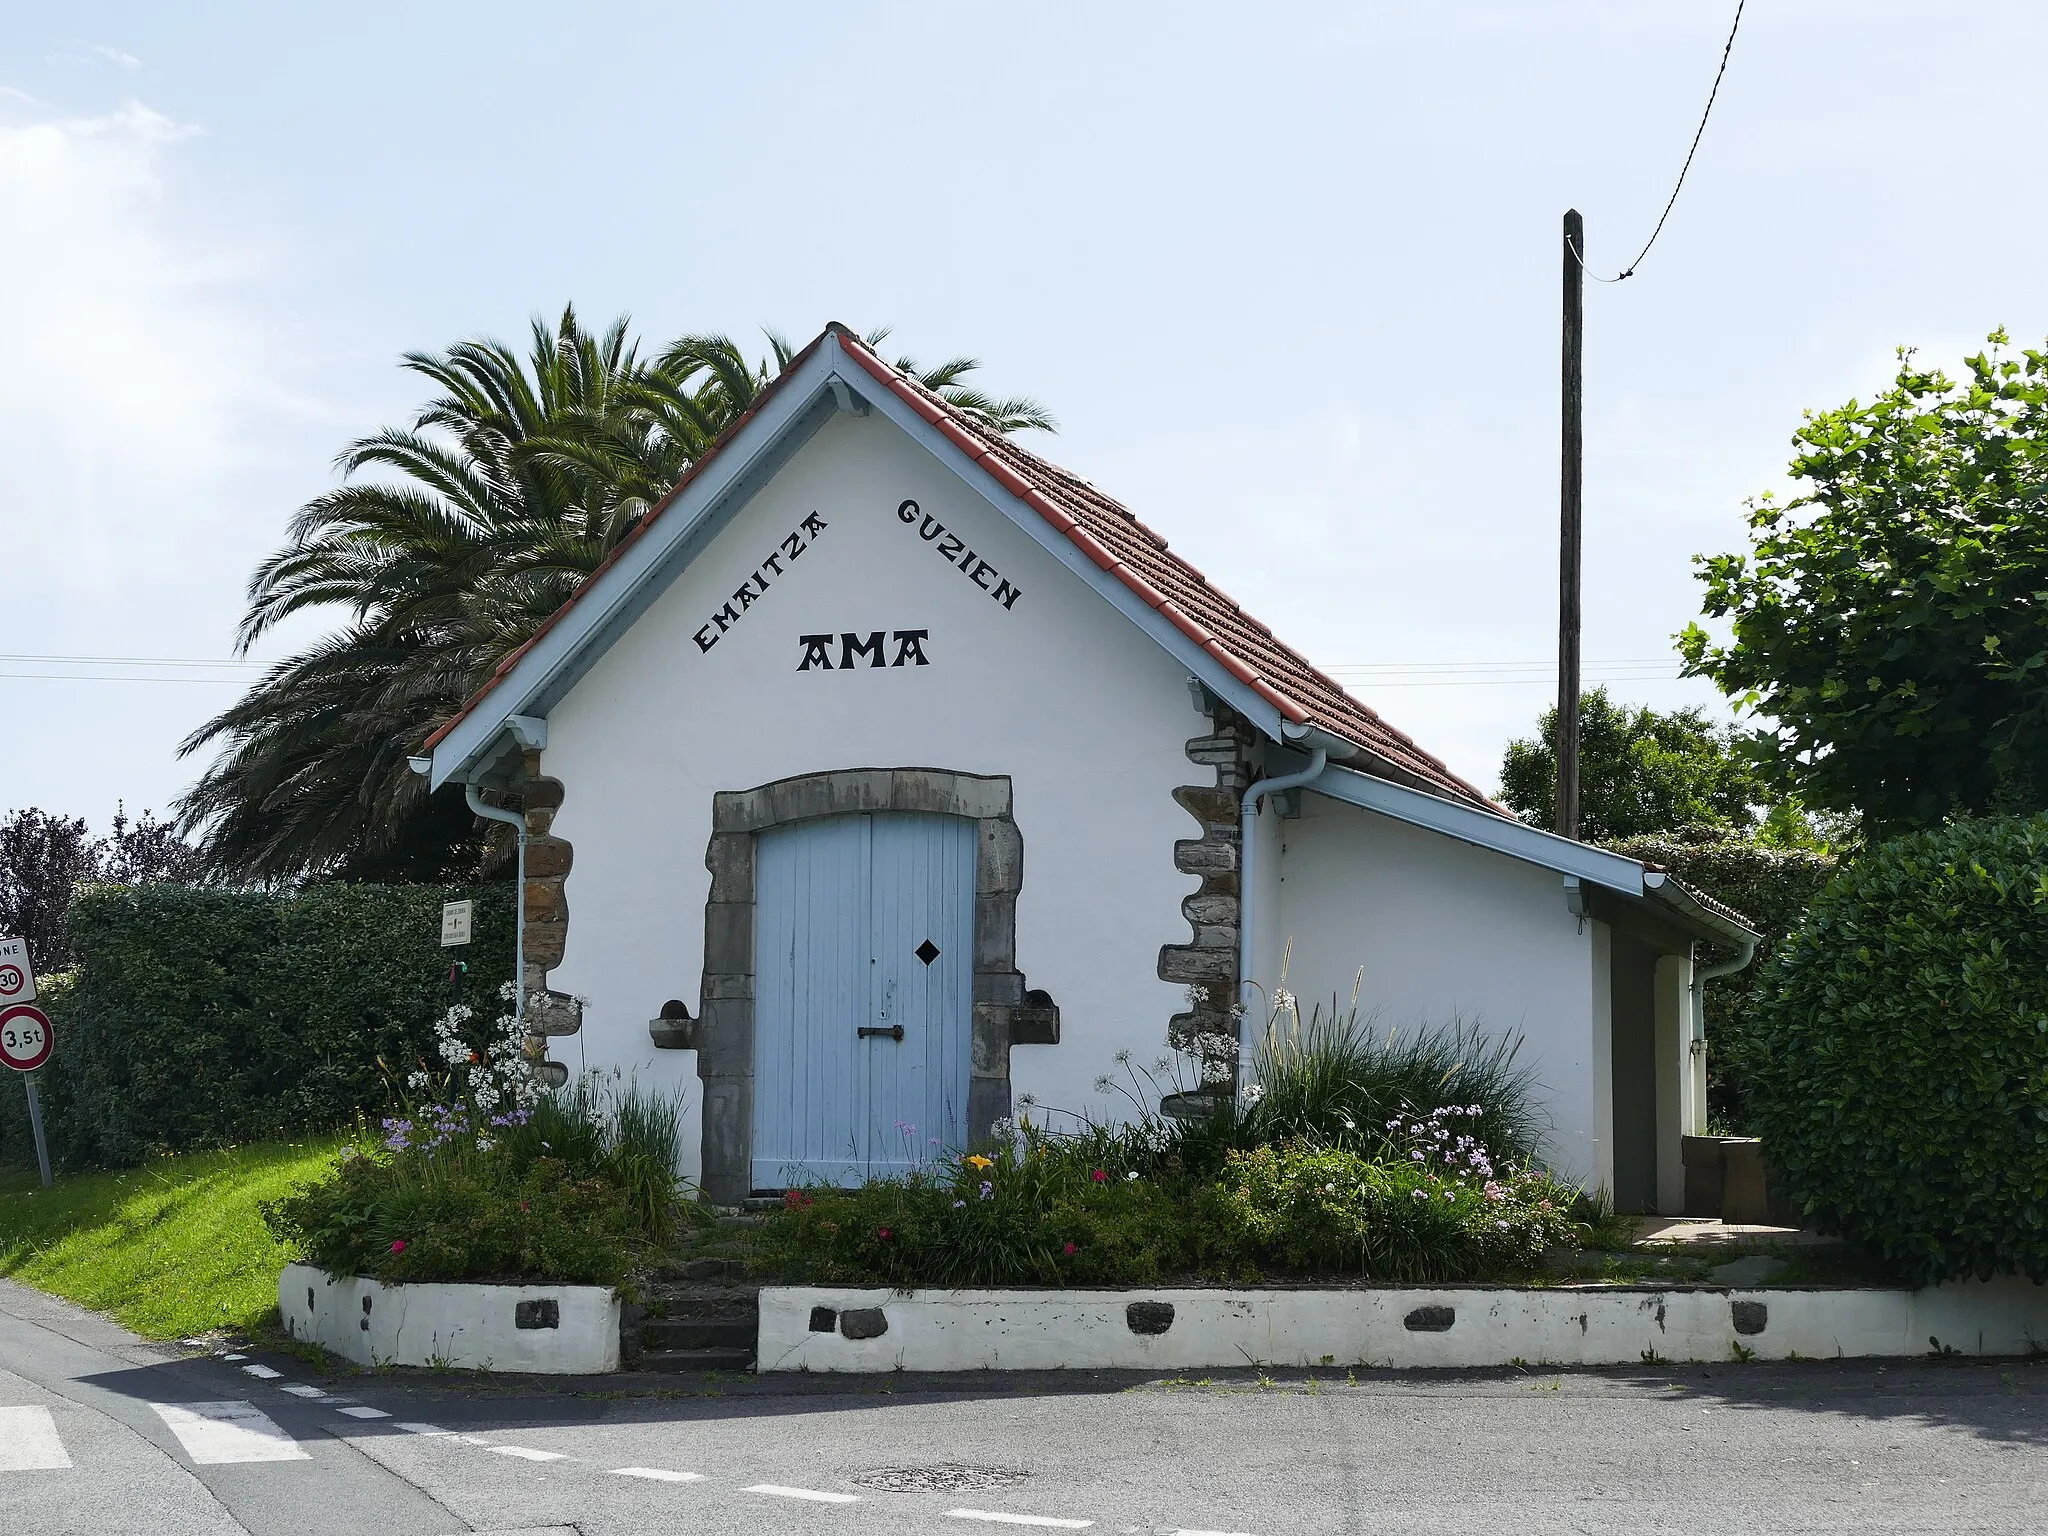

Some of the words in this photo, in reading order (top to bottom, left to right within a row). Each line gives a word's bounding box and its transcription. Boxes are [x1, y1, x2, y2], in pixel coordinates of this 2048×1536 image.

[693, 511, 828, 653] EMAITZA
[898, 500, 1022, 611] GUZIEN
[797, 630, 930, 671] AMA
[0, 945, 19, 956] NE
[0, 972, 18, 987] 30
[4, 1029, 43, 1048] 3,5t
